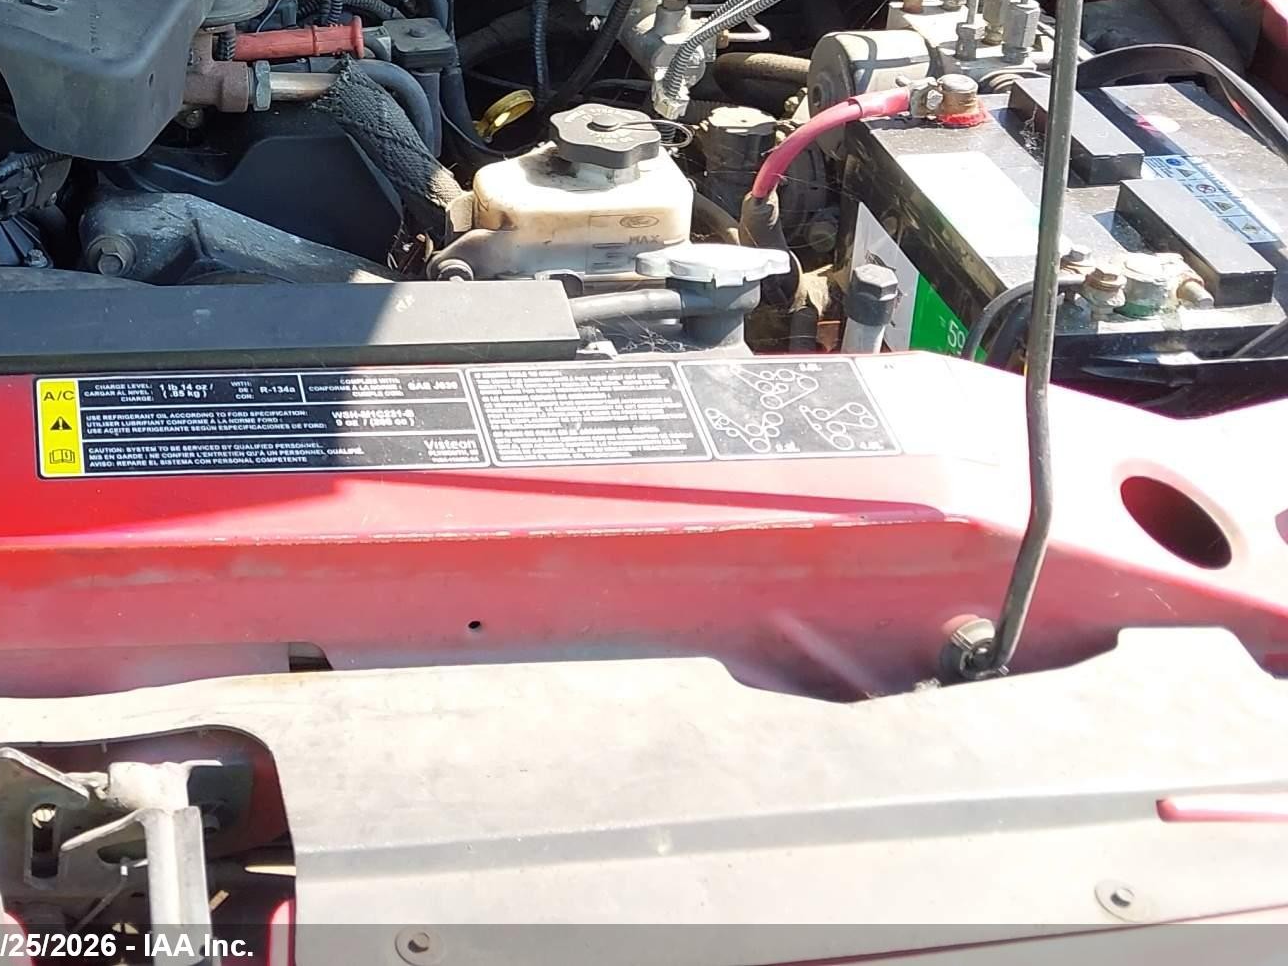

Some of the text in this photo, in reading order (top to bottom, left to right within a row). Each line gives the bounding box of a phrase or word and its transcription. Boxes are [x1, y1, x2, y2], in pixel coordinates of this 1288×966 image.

[629, 234, 660, 245] MAX
[168, 383, 178, 391] lb
[259, 386, 296, 394] R-134a
[43, 390, 75, 401] A/C
[424, 439, 477, 449] Visteon
